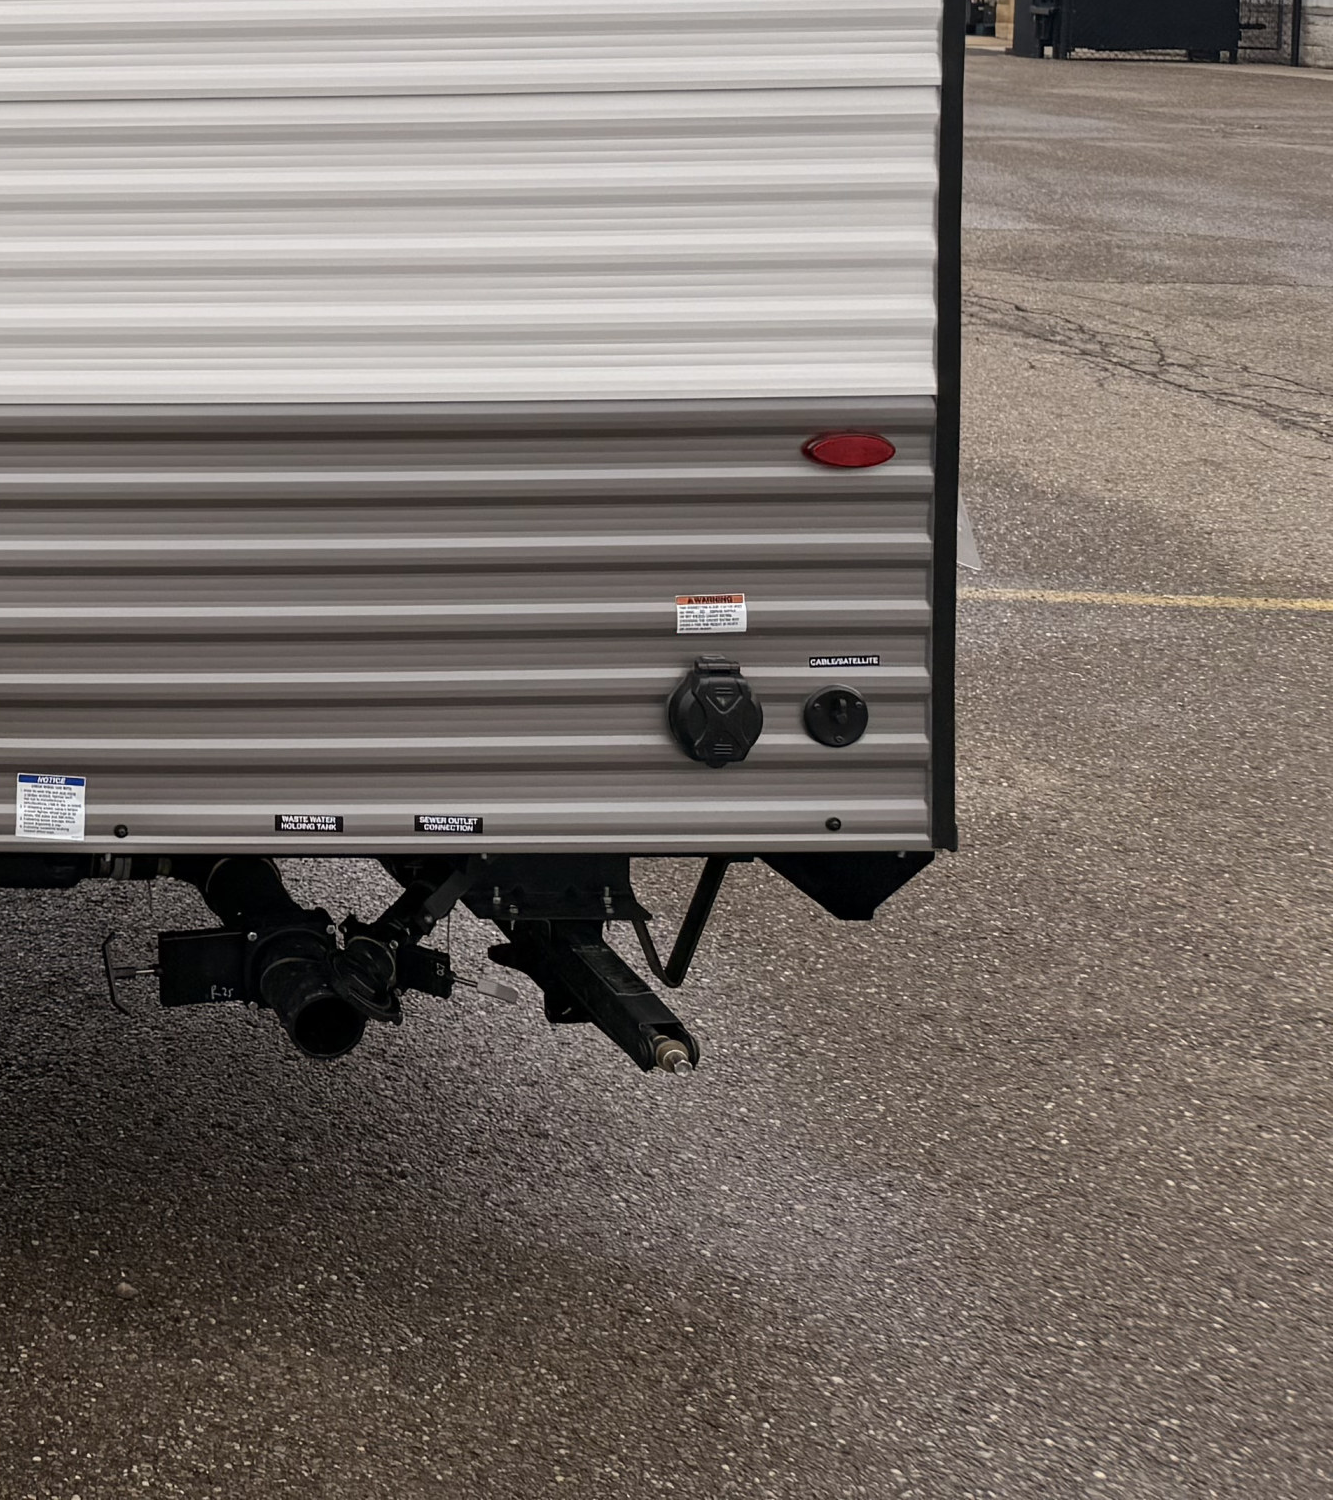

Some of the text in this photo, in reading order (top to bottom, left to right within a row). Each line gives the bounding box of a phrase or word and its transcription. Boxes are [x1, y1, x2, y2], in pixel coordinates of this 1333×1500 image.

[810, 657, 878, 666] CABLE/SATELLITE
[37, 776, 66, 785] NOTICE
[281, 815, 309, 823] WASTE
[419, 816, 478, 825] SEWER OUTLET
[281, 822, 336, 831] HOLDING TANK
[424, 824, 473, 832] CONNECTION
